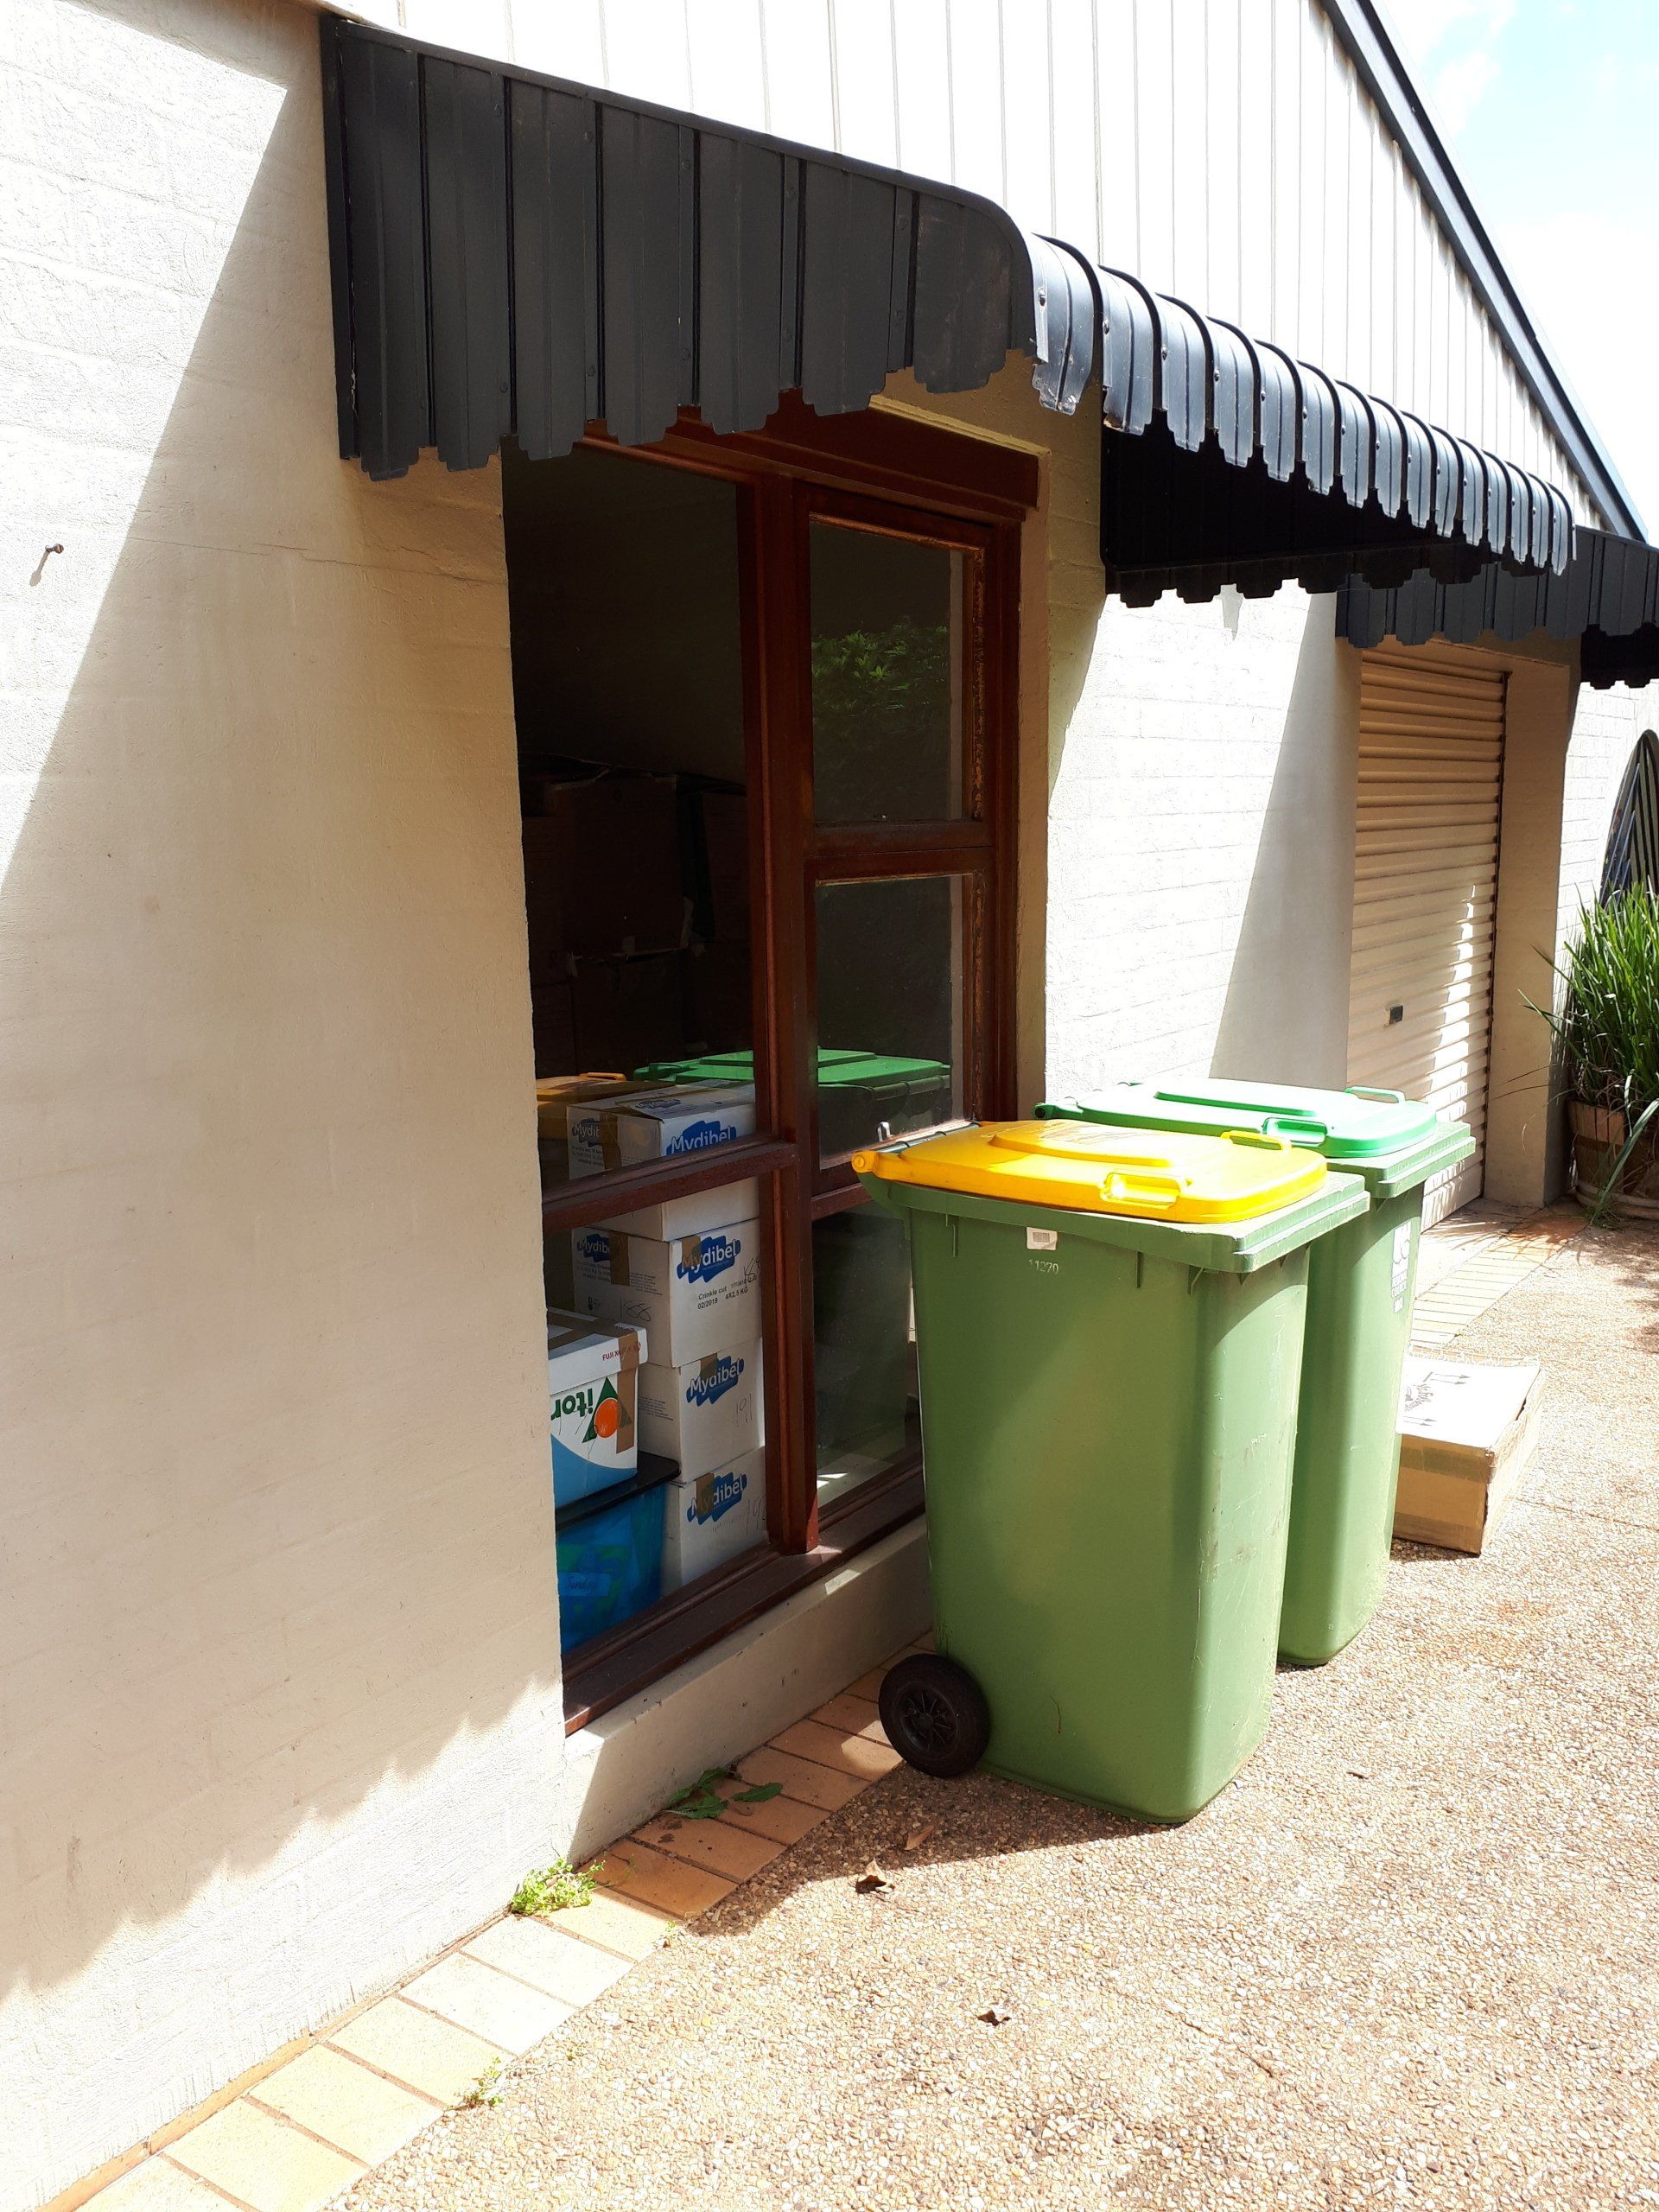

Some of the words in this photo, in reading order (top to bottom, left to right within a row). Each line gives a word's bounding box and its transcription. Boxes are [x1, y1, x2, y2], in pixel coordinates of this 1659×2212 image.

[579, 1236, 610, 1254] Mydib
[698, 1288, 718, 1300] Crinkle
[718, 1285, 728, 1294] cut
